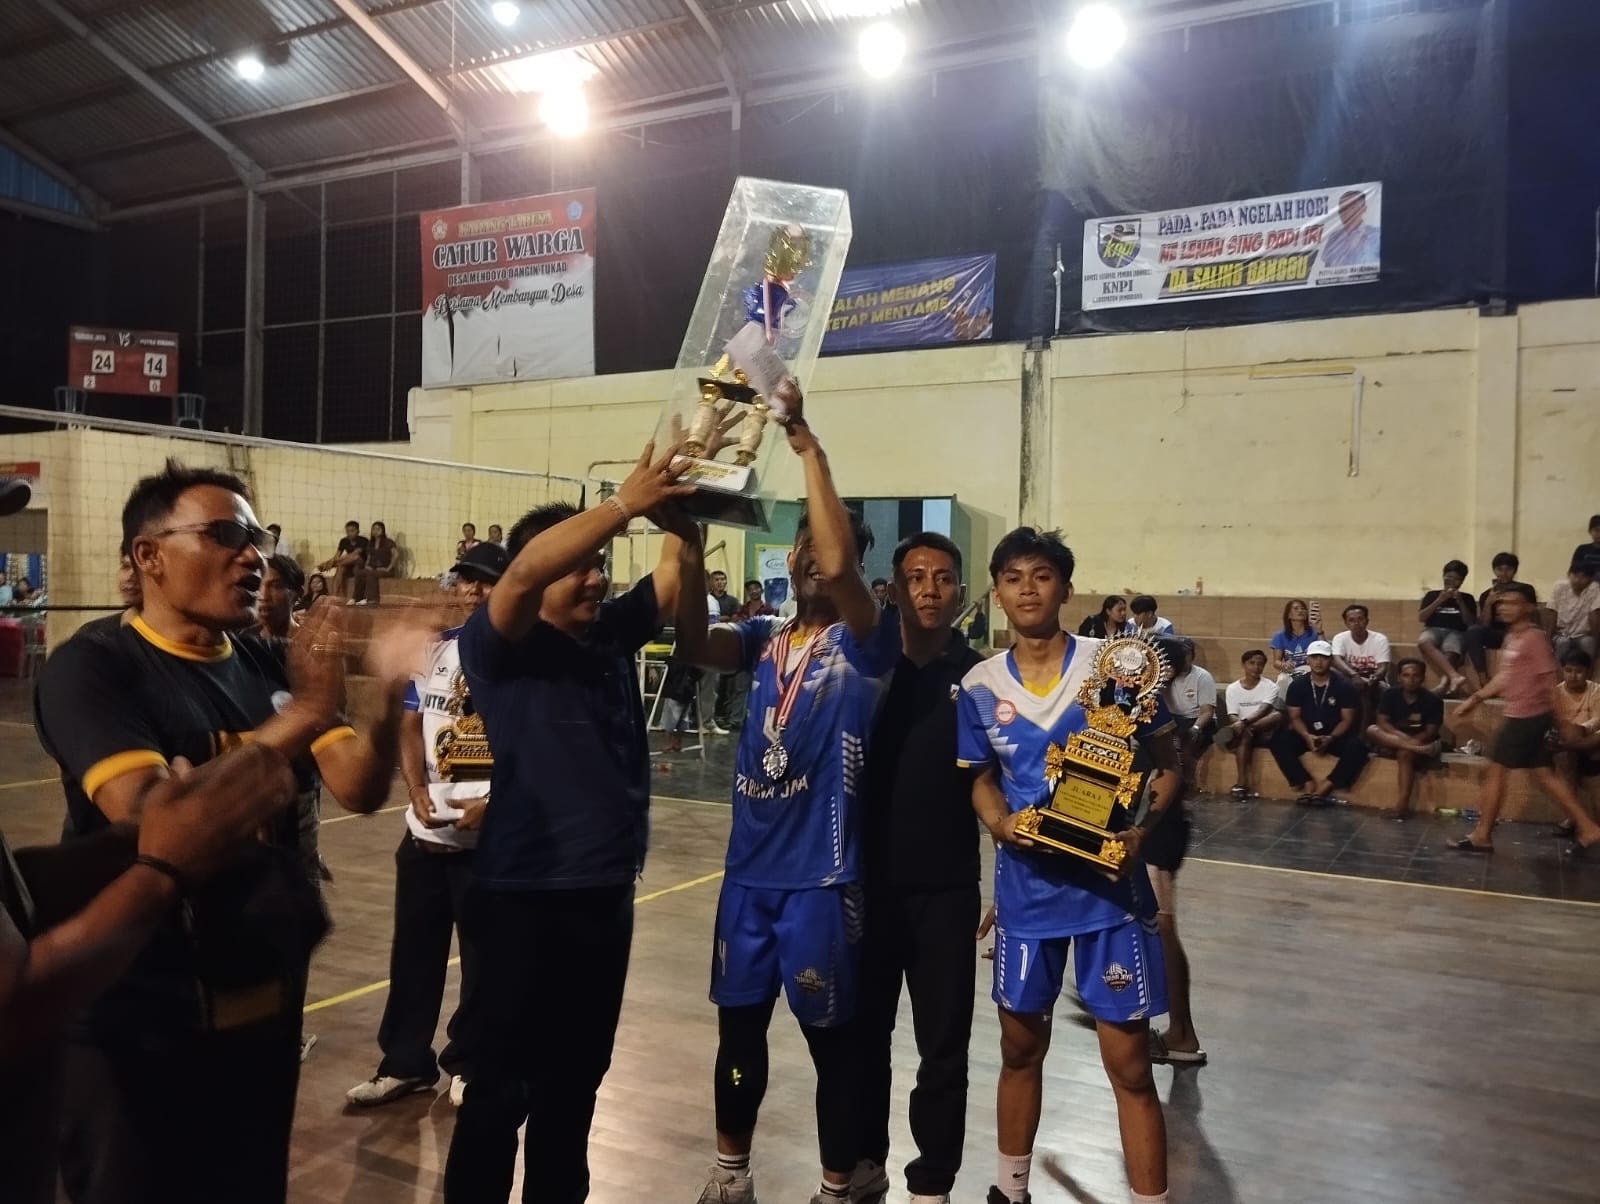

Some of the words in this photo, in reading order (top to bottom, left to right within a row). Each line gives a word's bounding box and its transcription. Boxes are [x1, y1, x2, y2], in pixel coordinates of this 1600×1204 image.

[1158, 214, 1192, 235] PADA
[1238, 200, 1293, 226] NGELAH
[1295, 196, 1329, 219] HOBI
[432, 239, 498, 270] CATUR
[503, 226, 585, 261] WARGA
[1226, 231, 1264, 256] SING
[1266, 227, 1300, 250] DADI
[448, 273, 469, 288] DESA
[469, 269, 507, 285] MENDOYO
[508, 265, 539, 280] DANGIN
[540, 261, 568, 277] TUKAD
[1103, 280, 1134, 294] KNPI
[433, 293, 481, 321] Bersama
[481, 288, 549, 313] Membangun
[551, 282, 584, 307] Desa
[881, 276, 957, 304] MENANG
[119, 331, 131, 347] VS
[94, 354, 112, 371] 24
[146, 357, 163, 374] 14
[1019, 943, 1029, 981] 1
